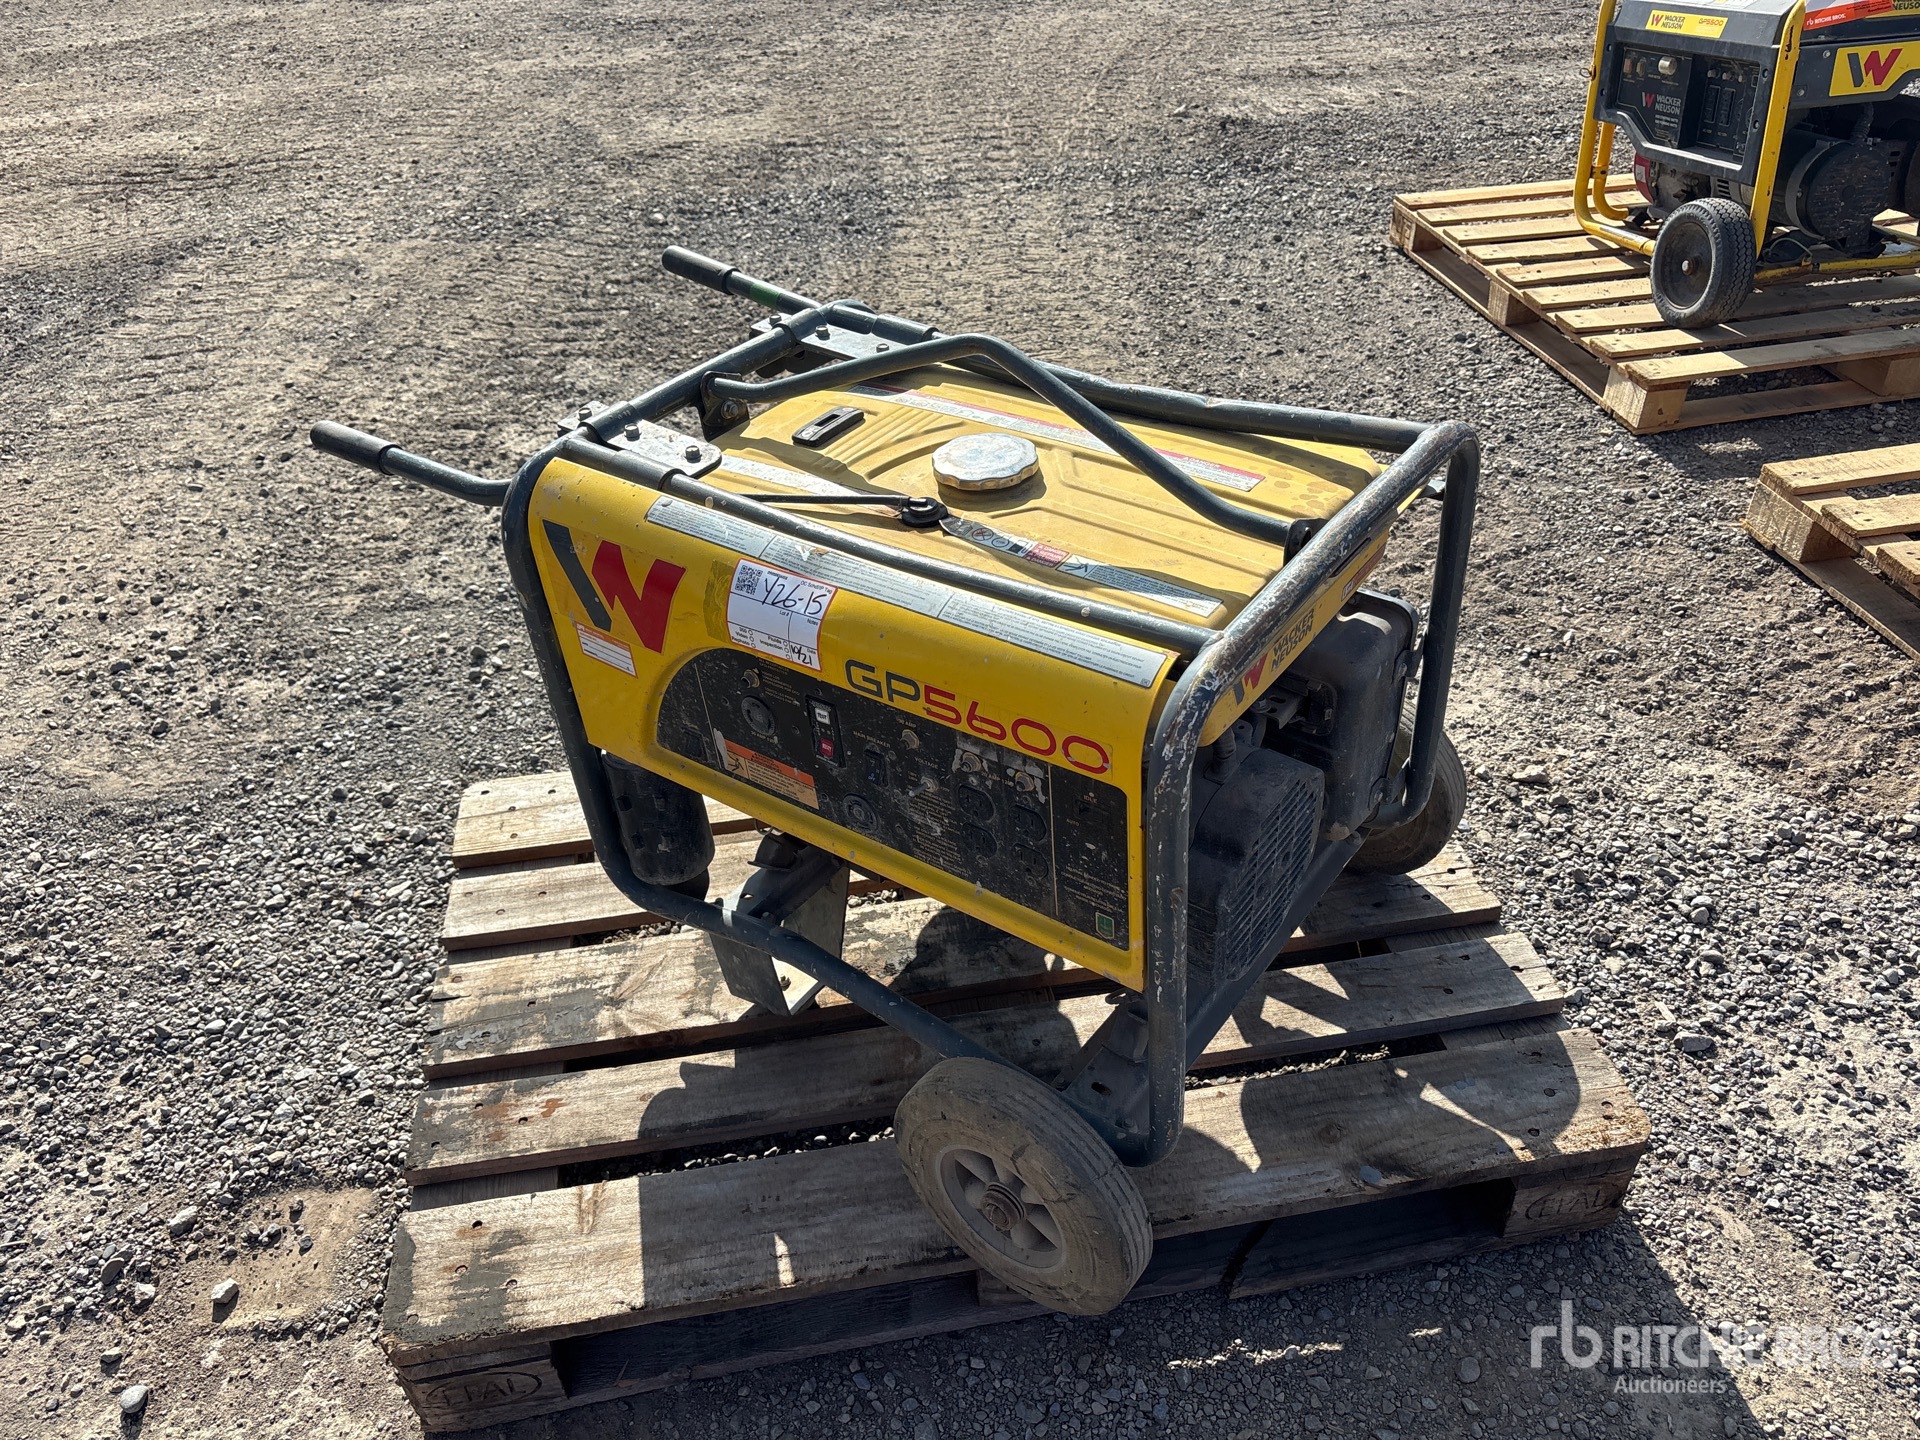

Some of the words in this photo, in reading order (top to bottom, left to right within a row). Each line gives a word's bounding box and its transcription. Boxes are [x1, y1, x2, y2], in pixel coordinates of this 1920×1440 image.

[1814, 15, 1832, 24] RITCHIE
[1661, 22, 1684, 30] NEUSON
[1656, 94, 1682, 106] WACKER
[1655, 104, 1681, 115] NEUSON
[1273, 608, 1315, 656] WACKER
[1271, 620, 1314, 672] NEUSON
[845, 659, 1110, 775] GP5600
[866, 735, 891, 748] BREAKER
[914, 757, 939, 770] VOLTAGE
[1083, 795, 1098, 804] IDLE
